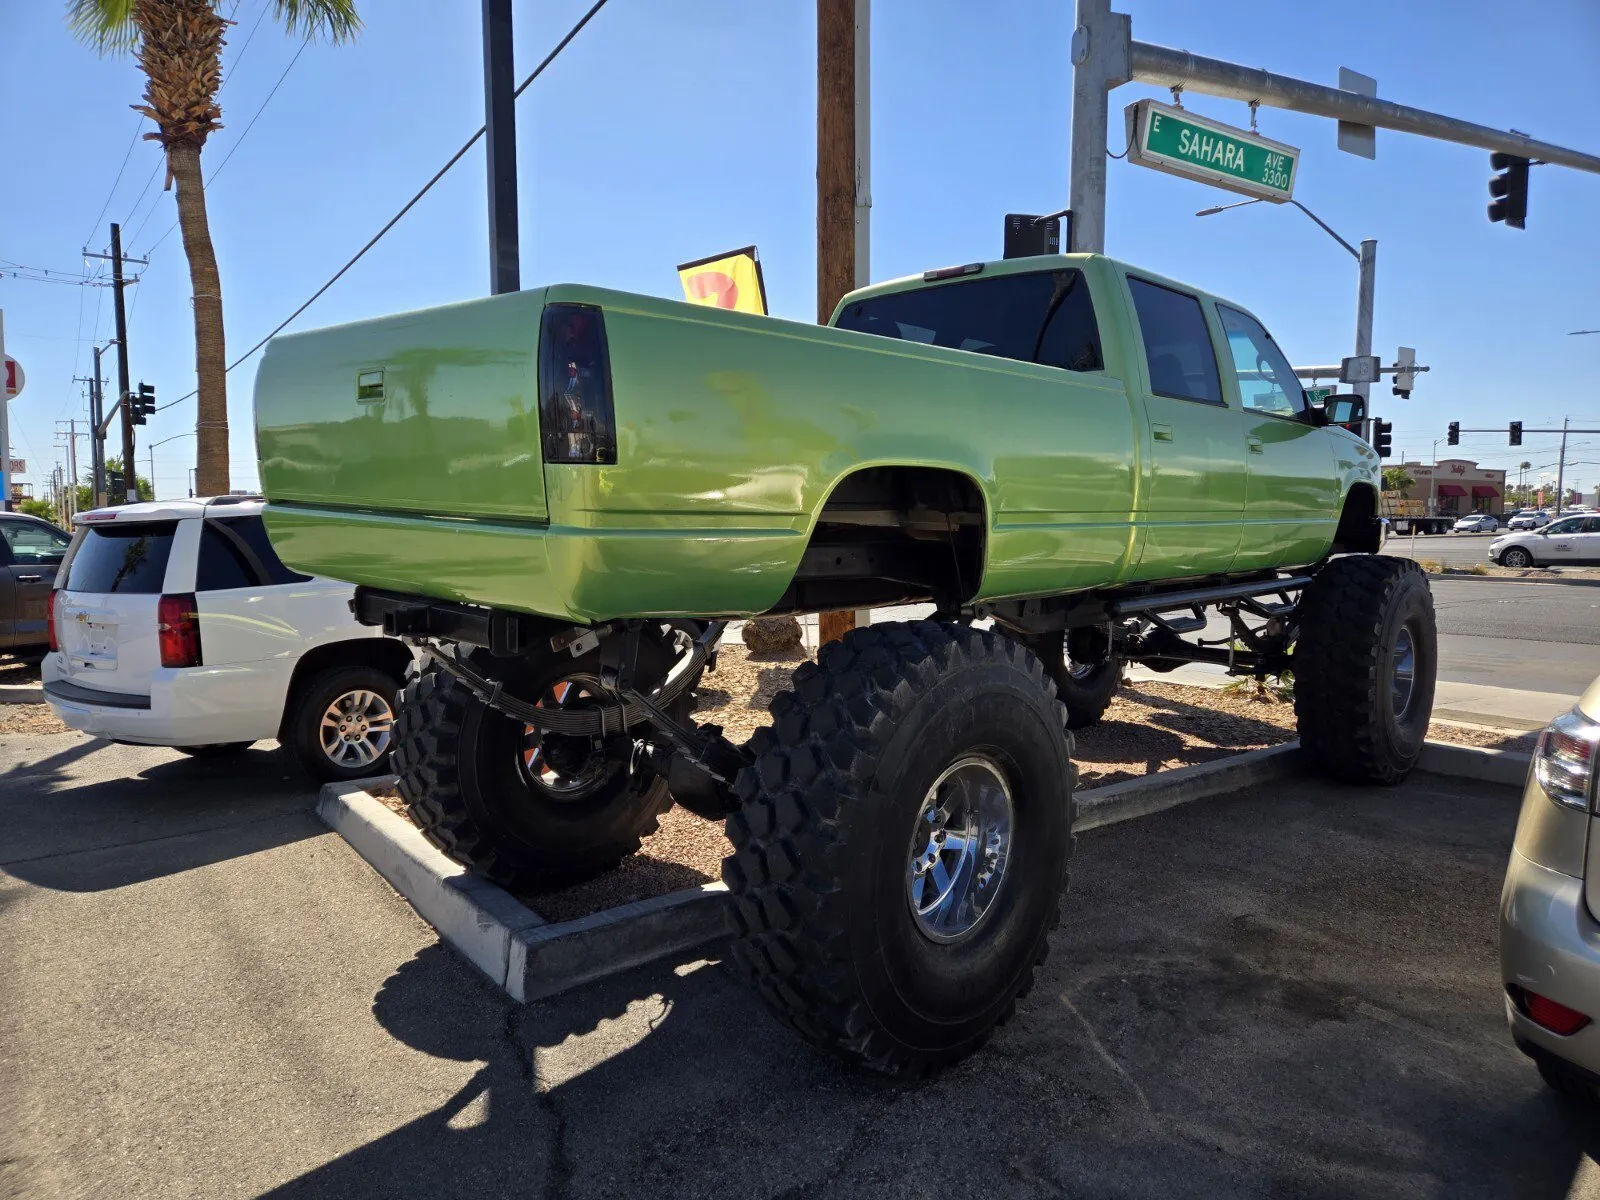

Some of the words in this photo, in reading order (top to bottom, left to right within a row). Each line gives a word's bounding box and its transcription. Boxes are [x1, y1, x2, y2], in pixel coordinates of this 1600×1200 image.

[1153, 115, 1162, 132] E
[1178, 128, 1244, 172] SAHARA
[1264, 152, 1285, 172] AVE
[1261, 168, 1288, 188] 3300
